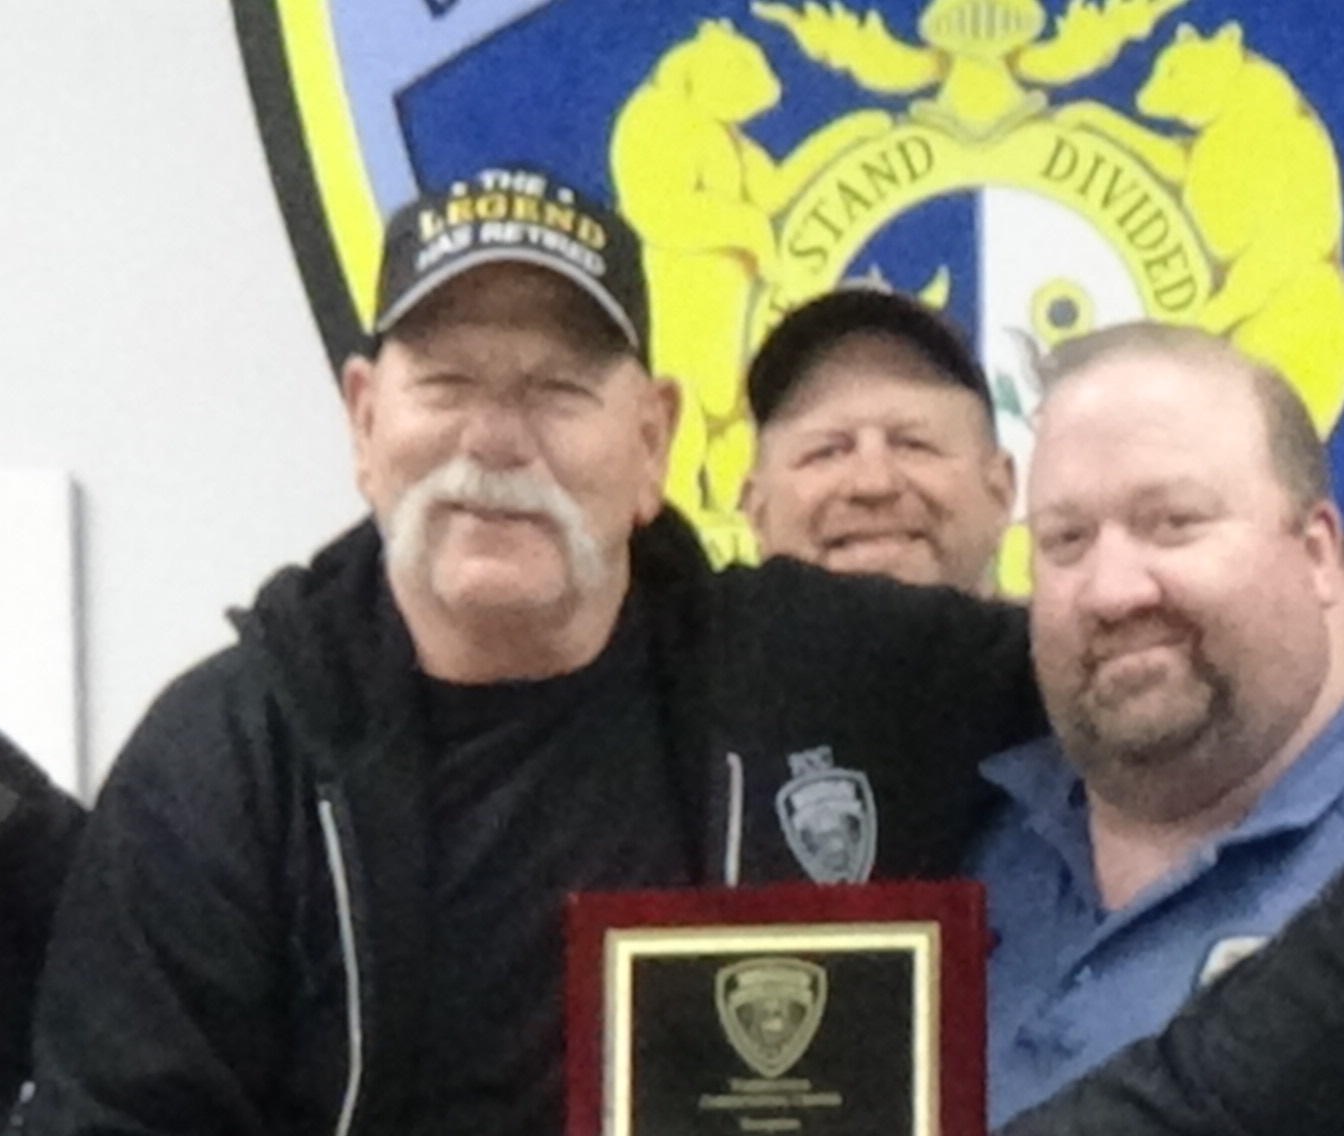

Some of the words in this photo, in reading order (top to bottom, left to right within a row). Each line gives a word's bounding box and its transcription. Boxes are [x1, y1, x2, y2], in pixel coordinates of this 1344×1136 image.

[478, 168, 548, 197] THE
[418, 193, 606, 250] LEGEND
[479, 221, 606, 277] RETIRED
[788, 133, 935, 274] STAND
[1041, 137, 1199, 313] DIVIDED
